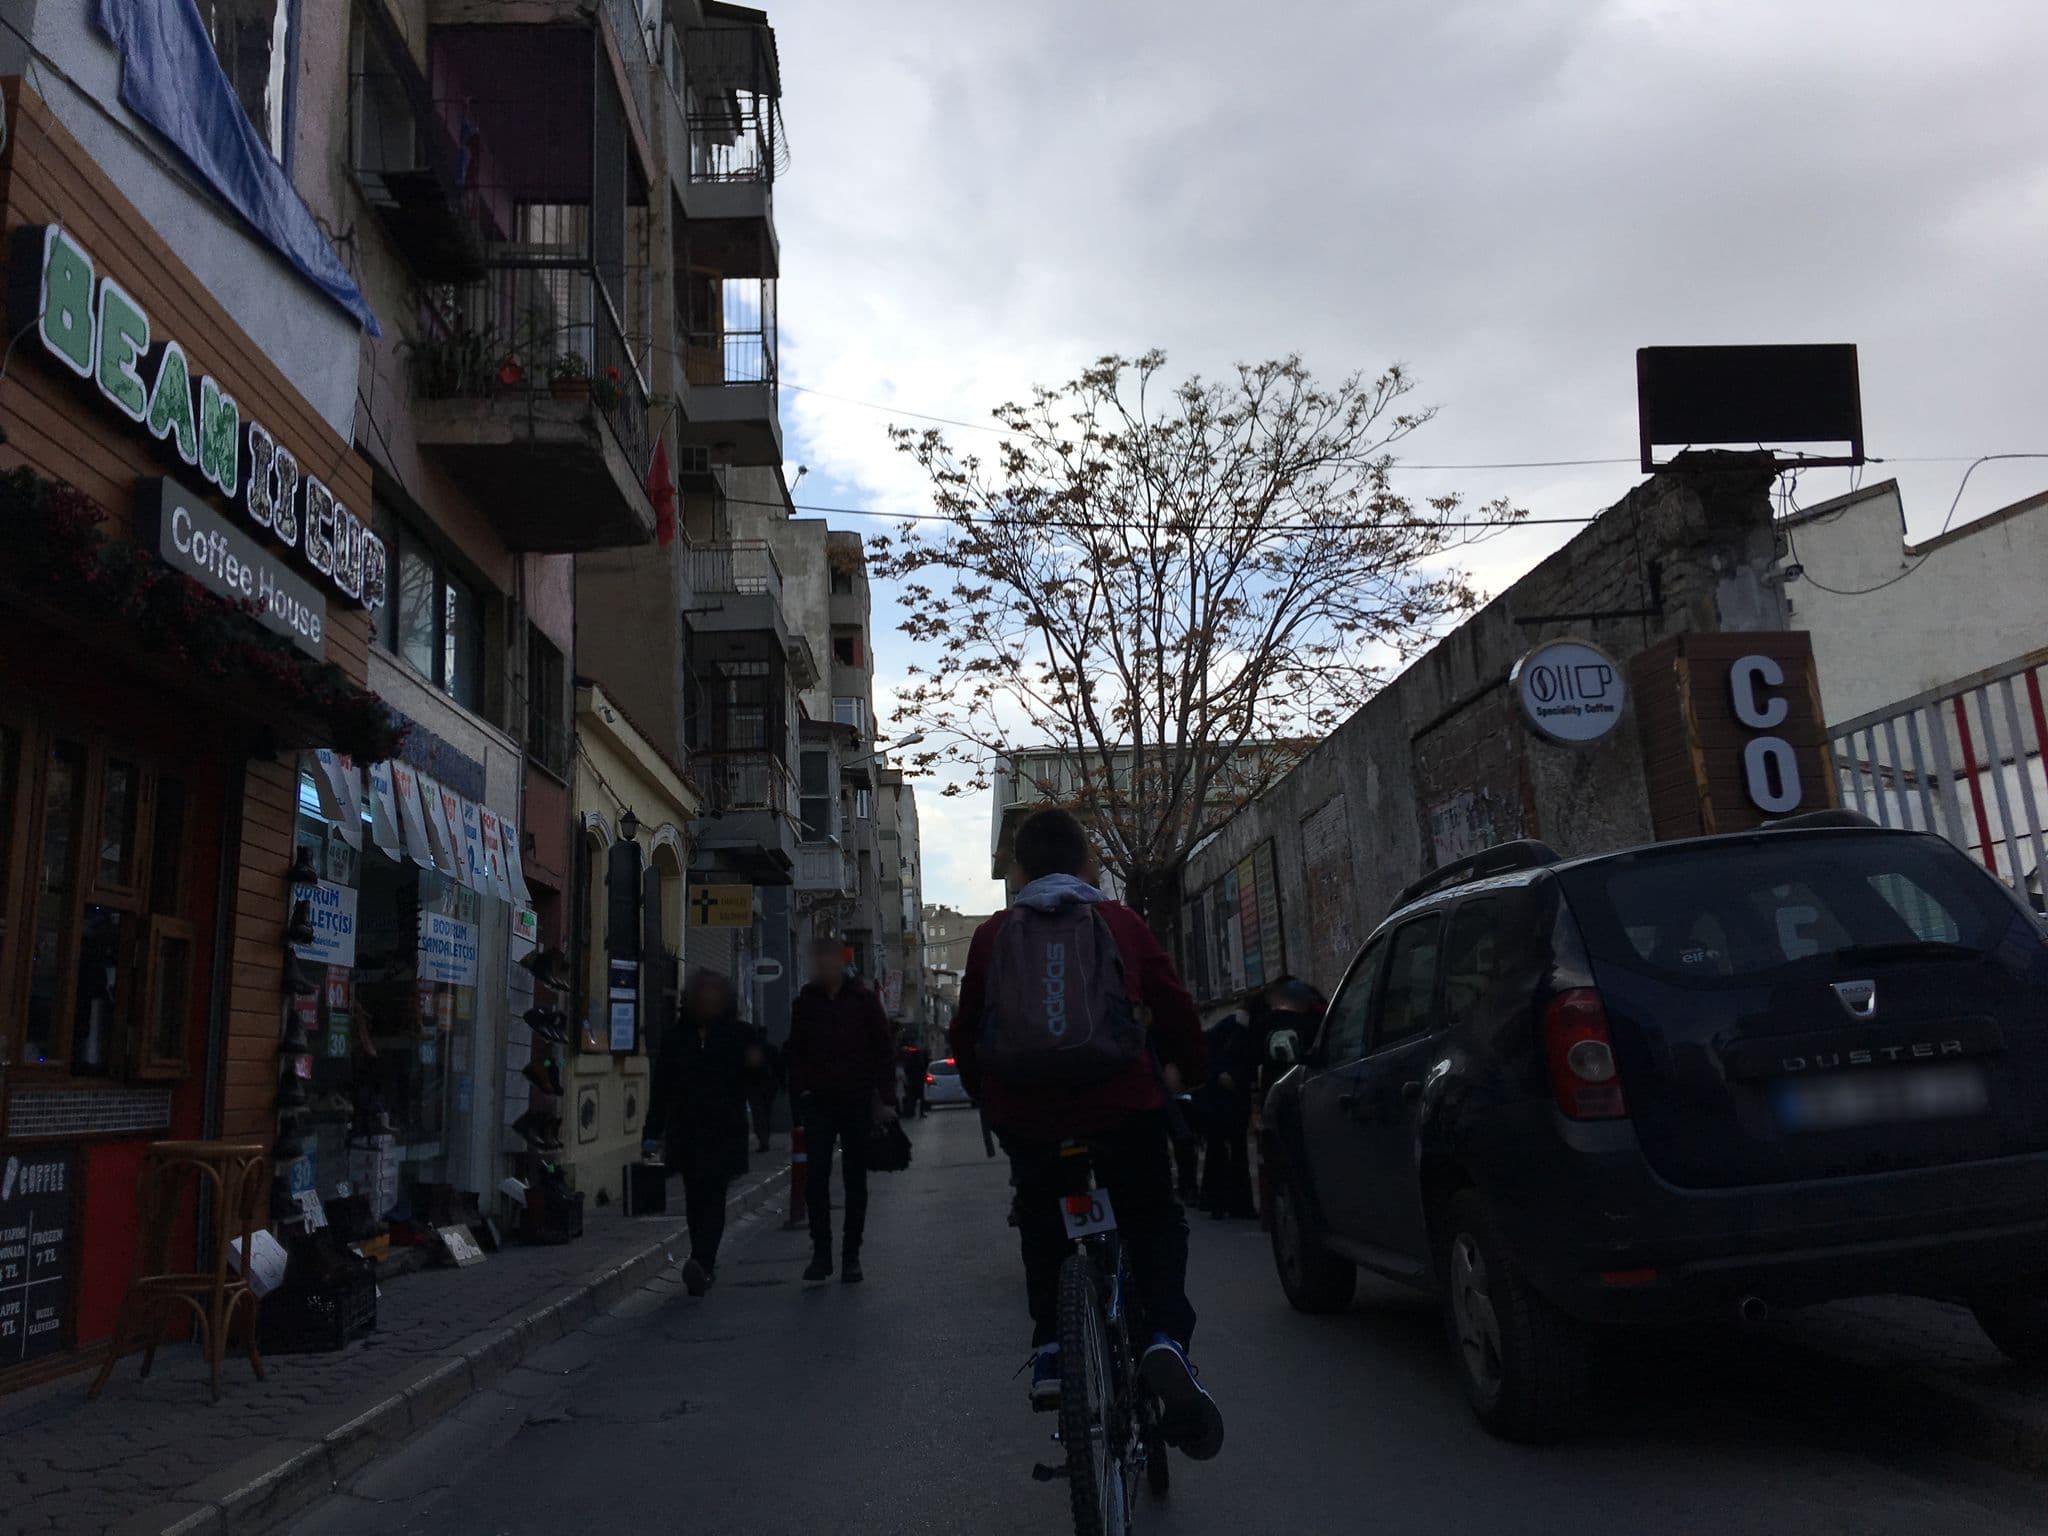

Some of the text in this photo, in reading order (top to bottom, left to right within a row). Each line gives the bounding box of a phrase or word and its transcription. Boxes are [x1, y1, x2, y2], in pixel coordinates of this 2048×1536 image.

[38, 223, 240, 498] BEAN
[304, 474, 386, 610] CUP
[172, 506, 321, 643] Coffee House
[1585, 703, 1614, 714] Coffee
[295, 885, 339, 908] ODRUM
[1042, 943, 1067, 1037] adidas
[1782, 1040, 1963, 1072] DUSTER
[19, 1162, 65, 1195] COFFEE
